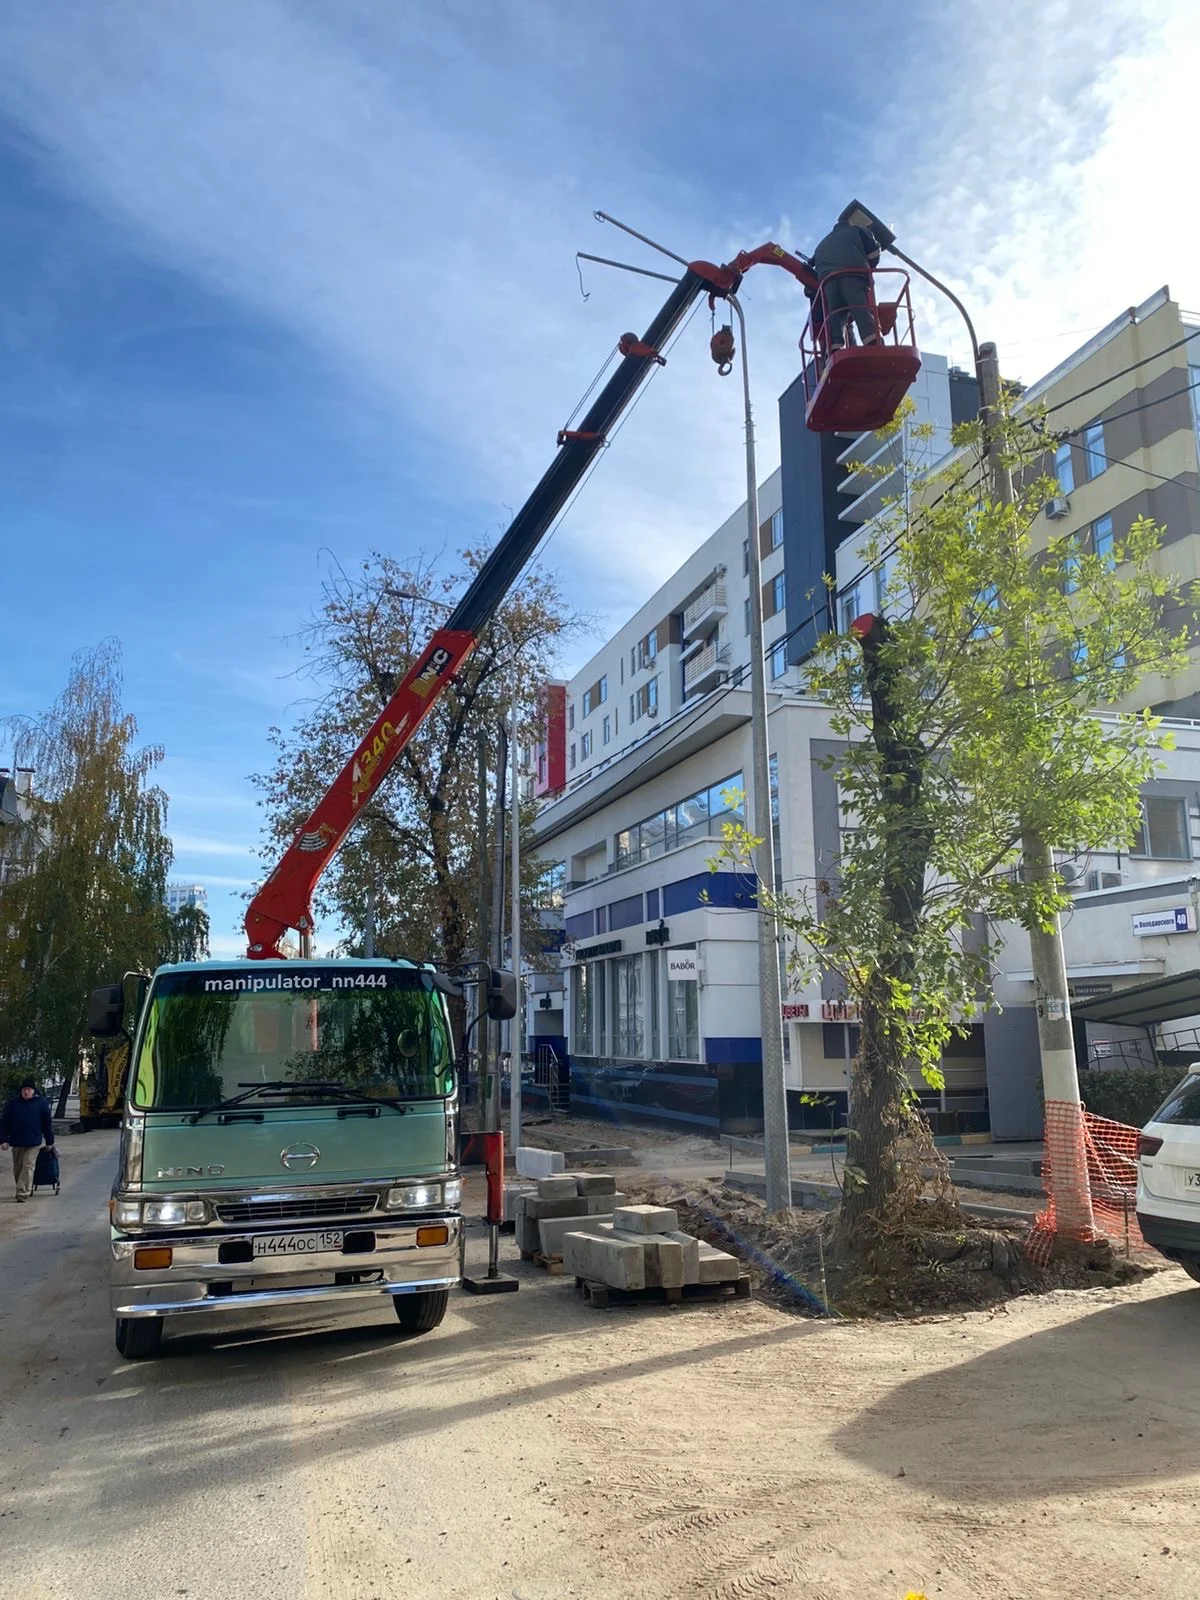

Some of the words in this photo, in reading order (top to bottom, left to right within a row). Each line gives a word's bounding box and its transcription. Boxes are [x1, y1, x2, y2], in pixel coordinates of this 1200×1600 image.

[1176, 913, 1187, 926] 40
[204, 973, 388, 993] manipulator_nn444
[156, 1163, 225, 1178] HINO
[257, 1236, 316, 1254] Н444ОС
[319, 1232, 340, 1245] 152
